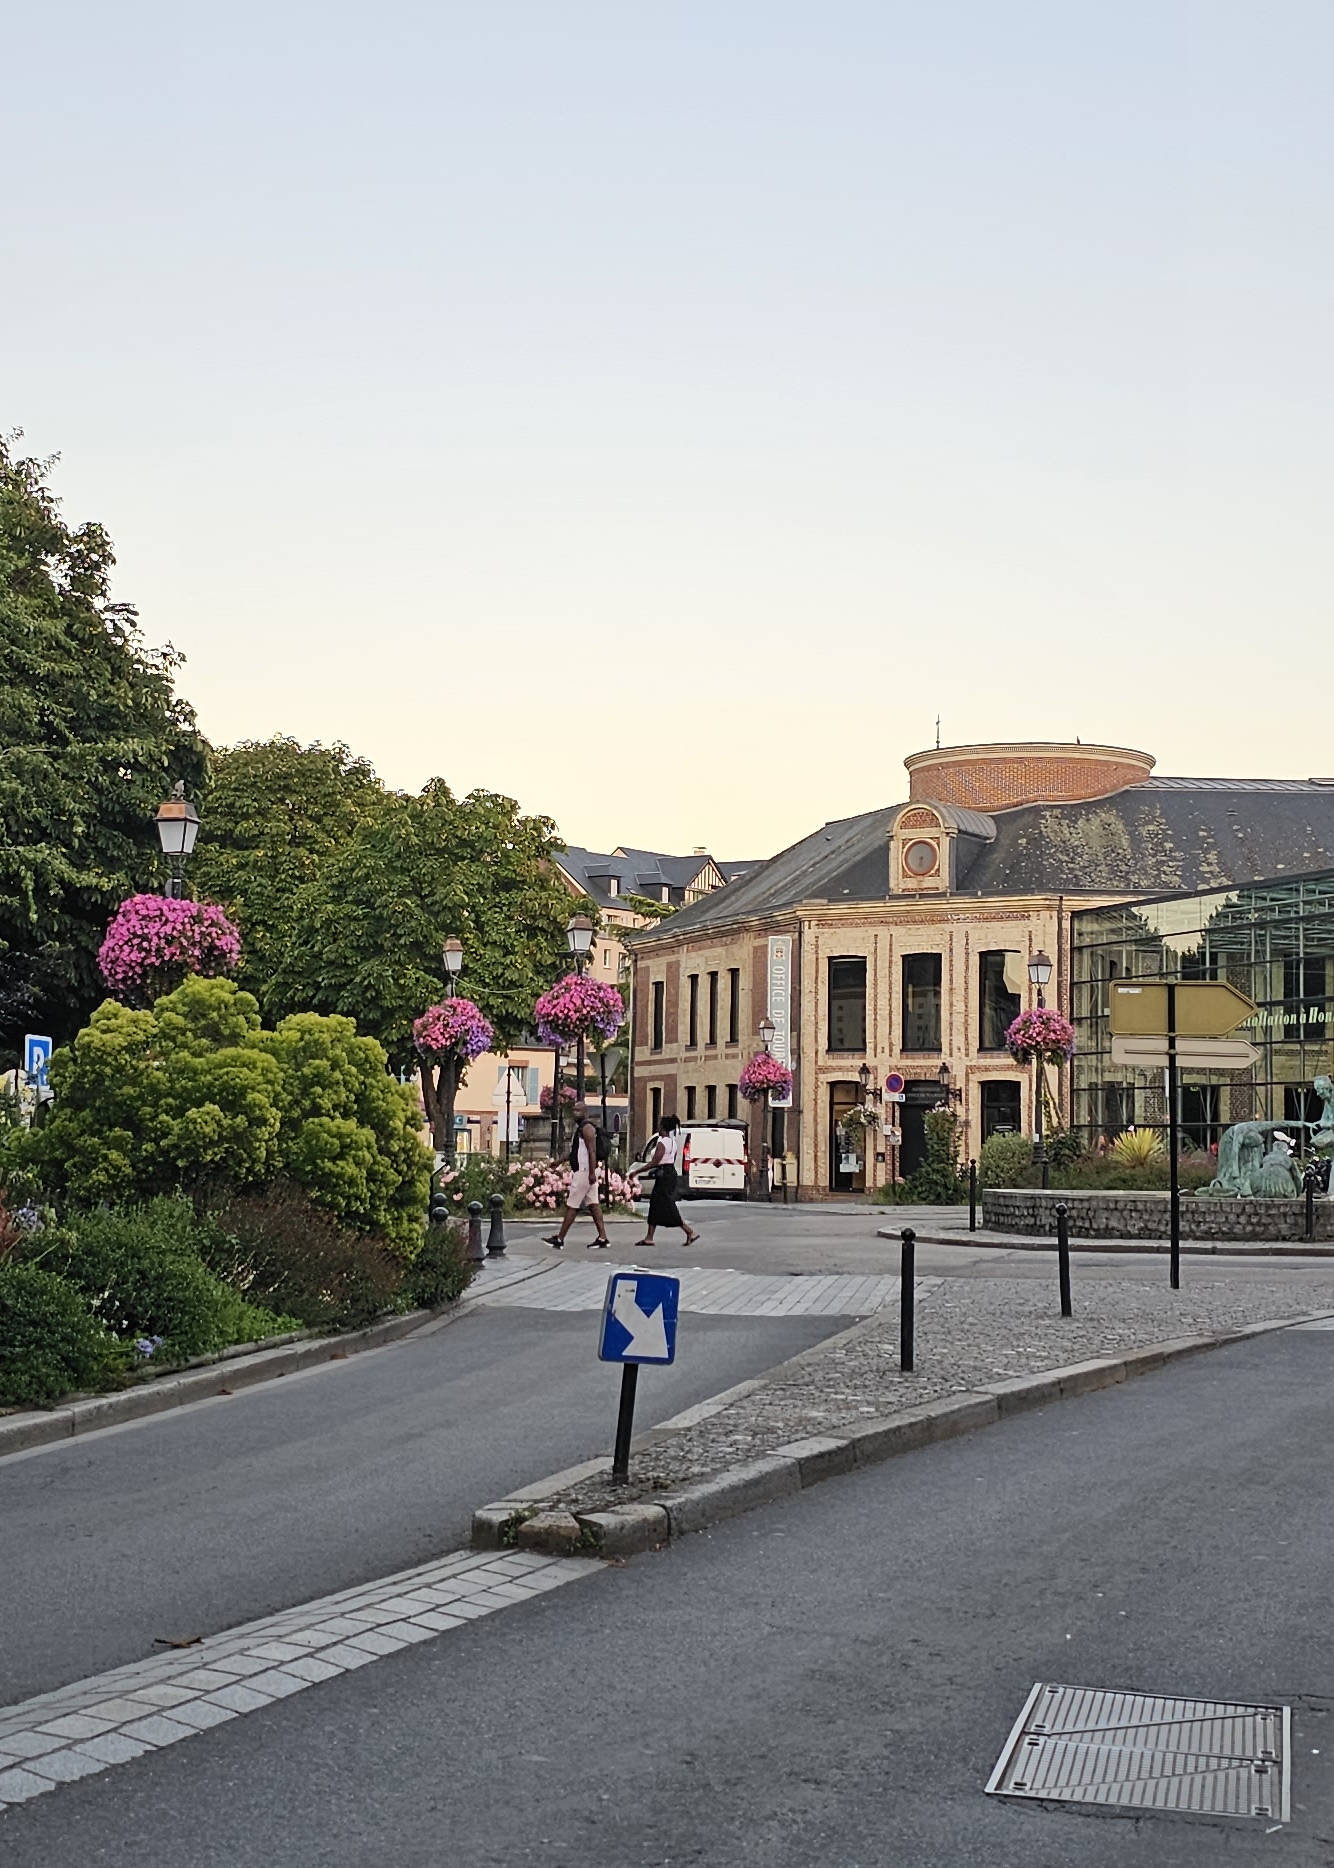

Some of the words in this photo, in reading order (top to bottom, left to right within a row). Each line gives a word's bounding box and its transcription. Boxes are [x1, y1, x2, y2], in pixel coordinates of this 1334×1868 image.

[771, 966, 786, 1004] OFFICE
[771, 1009, 786, 1025] DE
[1299, 1008, 1307, 1024] à
